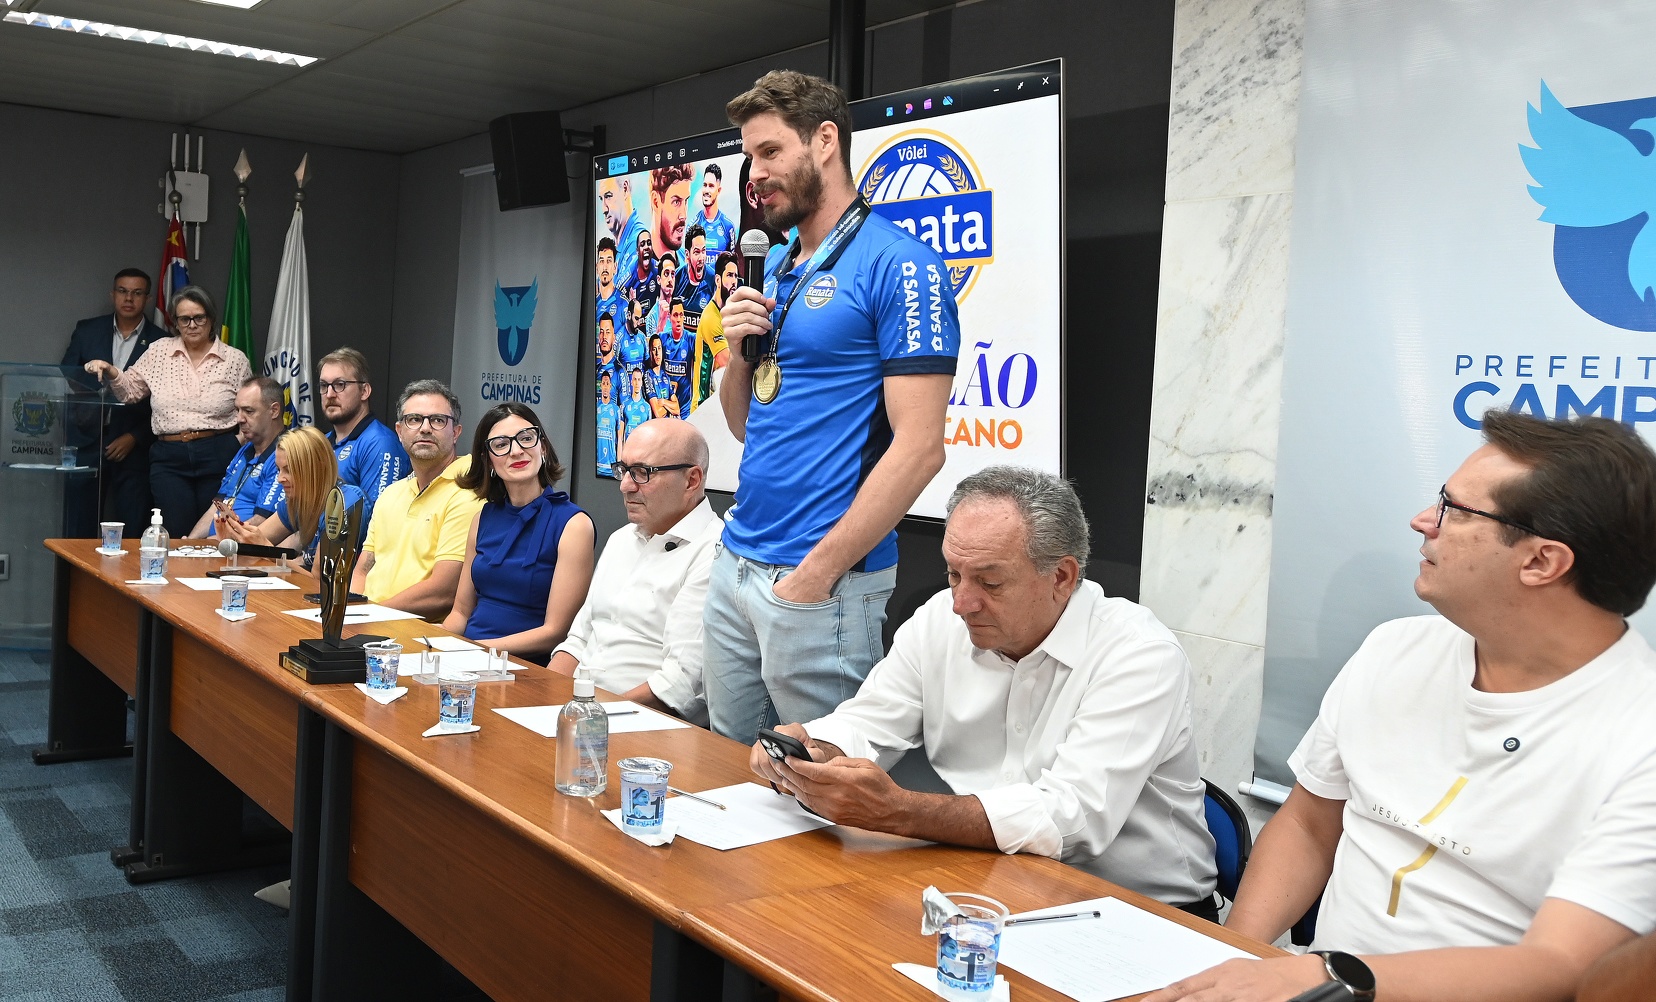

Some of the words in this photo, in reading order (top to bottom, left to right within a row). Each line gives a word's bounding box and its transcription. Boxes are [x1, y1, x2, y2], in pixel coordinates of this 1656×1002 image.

[897, 144, 927, 162] Vôlei
[892, 204, 988, 254] nata
[806, 286, 834, 297] Renata
[926, 264, 942, 334] SANASA
[684, 315, 700, 326] enat
[903, 279, 921, 354] SANASA
[481, 372, 527, 383] PREFEITURA
[532, 375, 542, 384] DE
[664, 362, 686, 374] Renata
[948, 339, 1038, 409] ÃO
[1455, 354, 1656, 379] PREFEIT
[481, 382, 541, 405] CAMPINAS
[1453, 381, 1656, 431] CAMP
[11, 446, 54, 456] CAMPINAS
